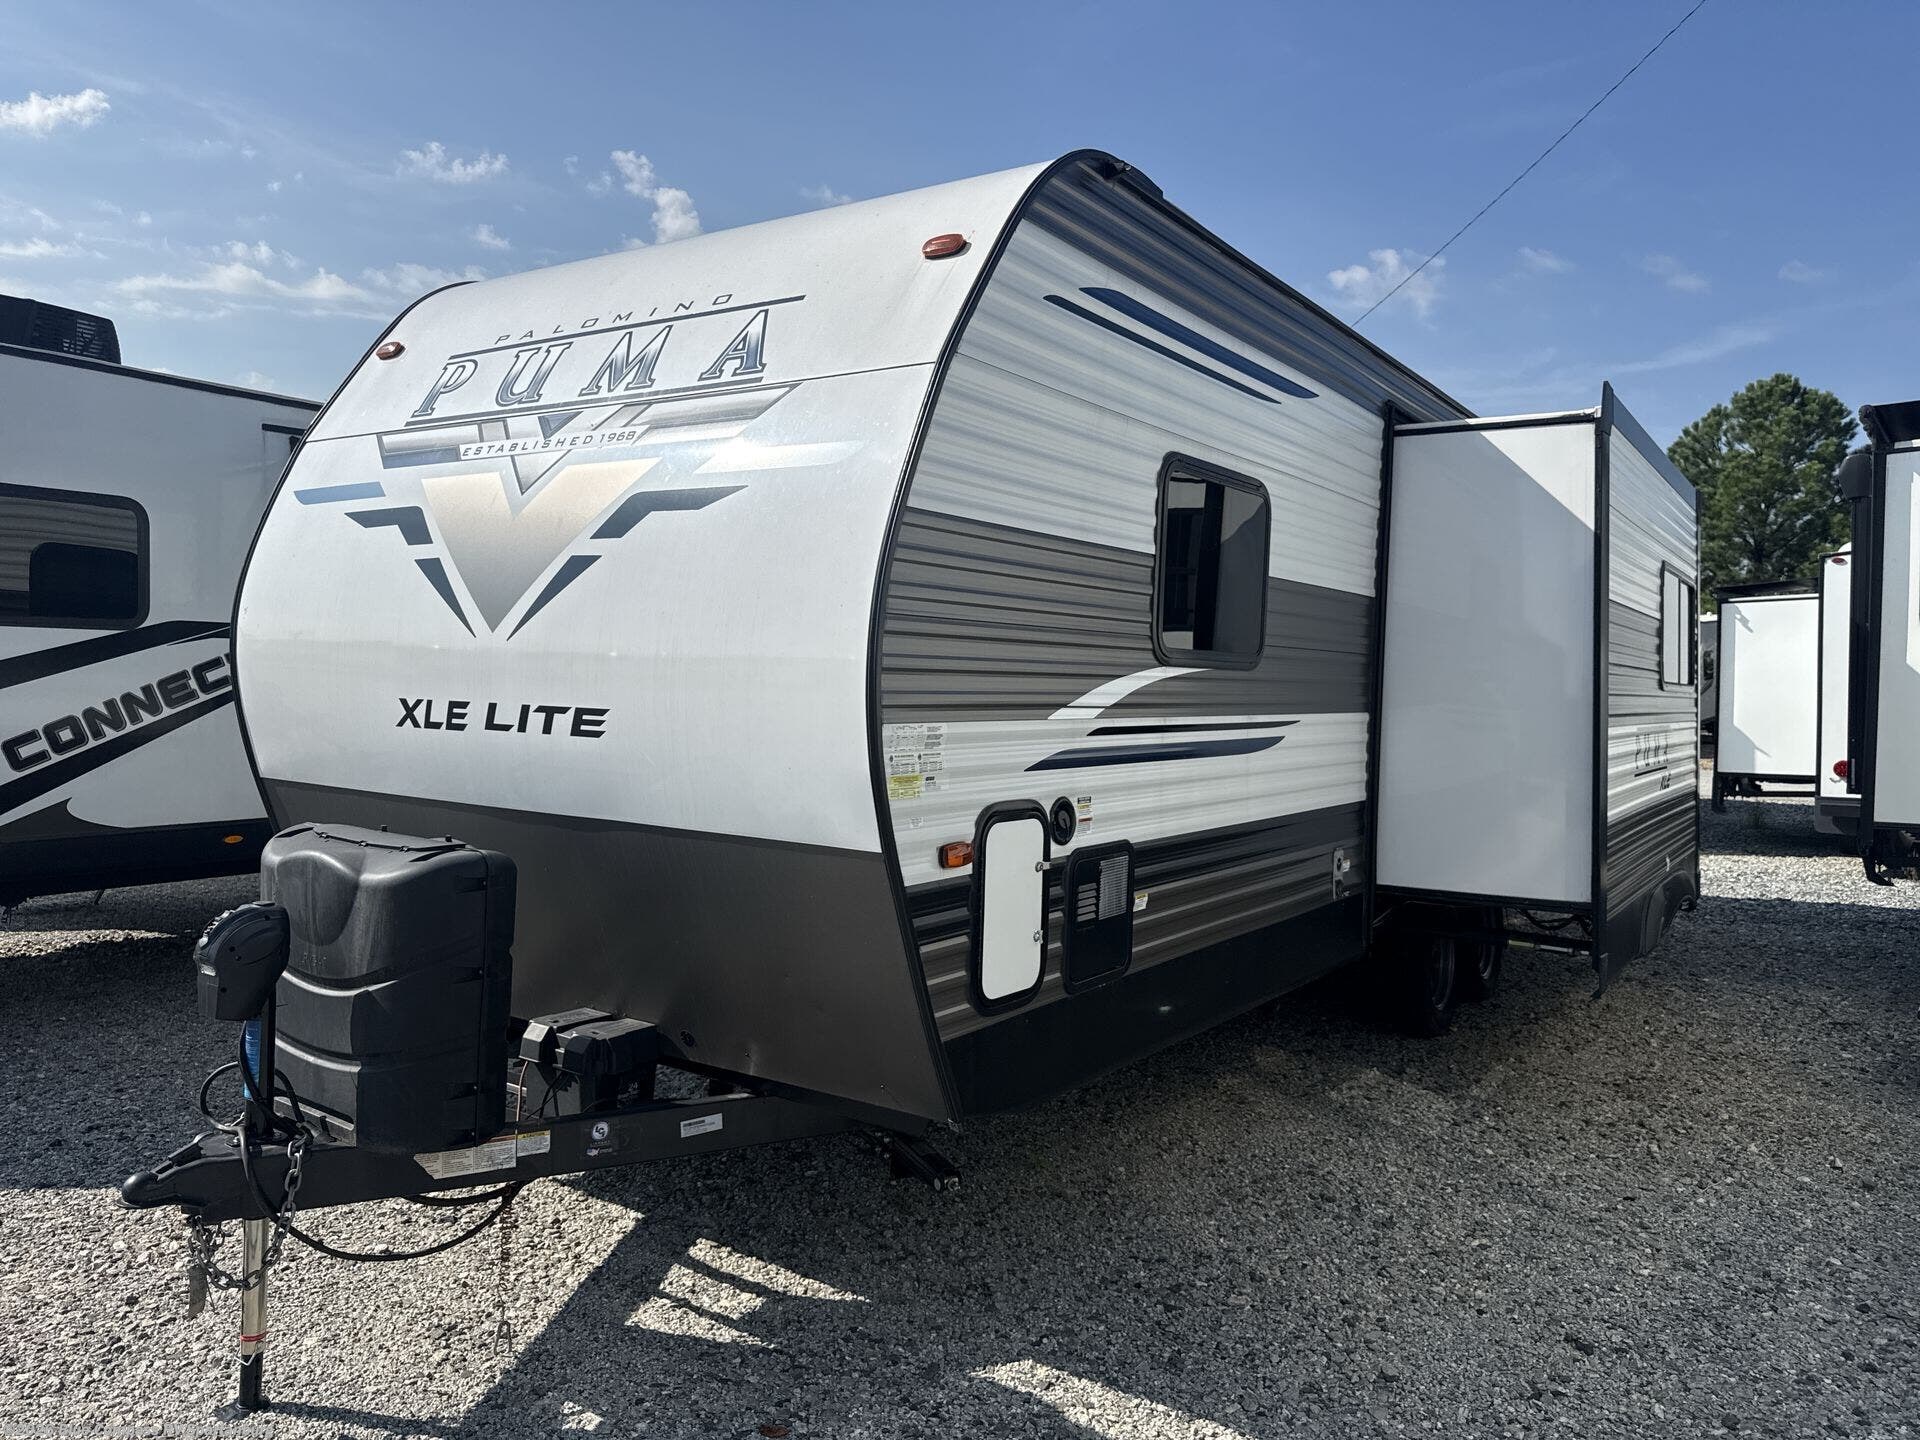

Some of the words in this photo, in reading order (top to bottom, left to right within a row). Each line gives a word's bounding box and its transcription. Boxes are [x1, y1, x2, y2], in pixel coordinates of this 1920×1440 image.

[494, 293, 733, 345] PALOMINO
[411, 308, 768, 418] PUMA
[462, 434, 594, 457] ESTABLISHED
[599, 430, 637, 444] 1968
[0, 651, 232, 772] CONNEC
[395, 697, 471, 731] XLE
[484, 702, 611, 738] LITE
